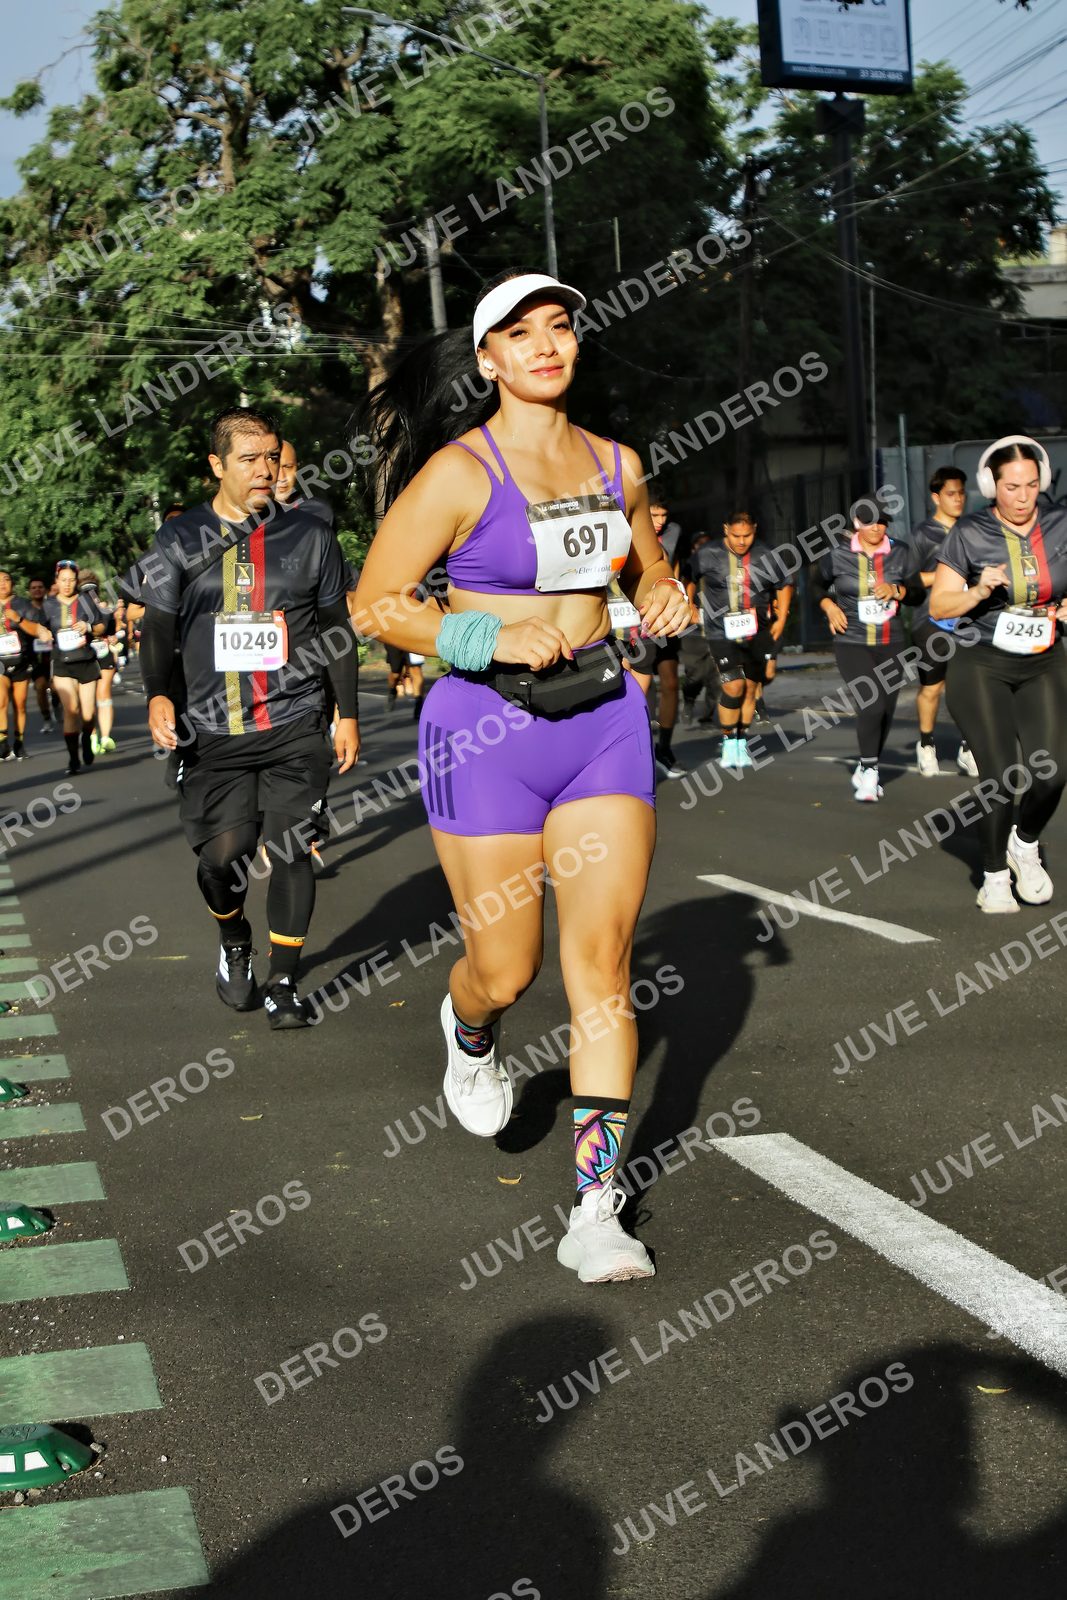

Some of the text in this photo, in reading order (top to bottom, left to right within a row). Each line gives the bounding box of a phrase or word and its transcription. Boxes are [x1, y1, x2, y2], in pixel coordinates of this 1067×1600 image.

[563, 522, 609, 558] 697
[729, 617, 751, 628] 9289
[1005, 621, 1044, 638] 9245
[220, 631, 278, 650] 10249
